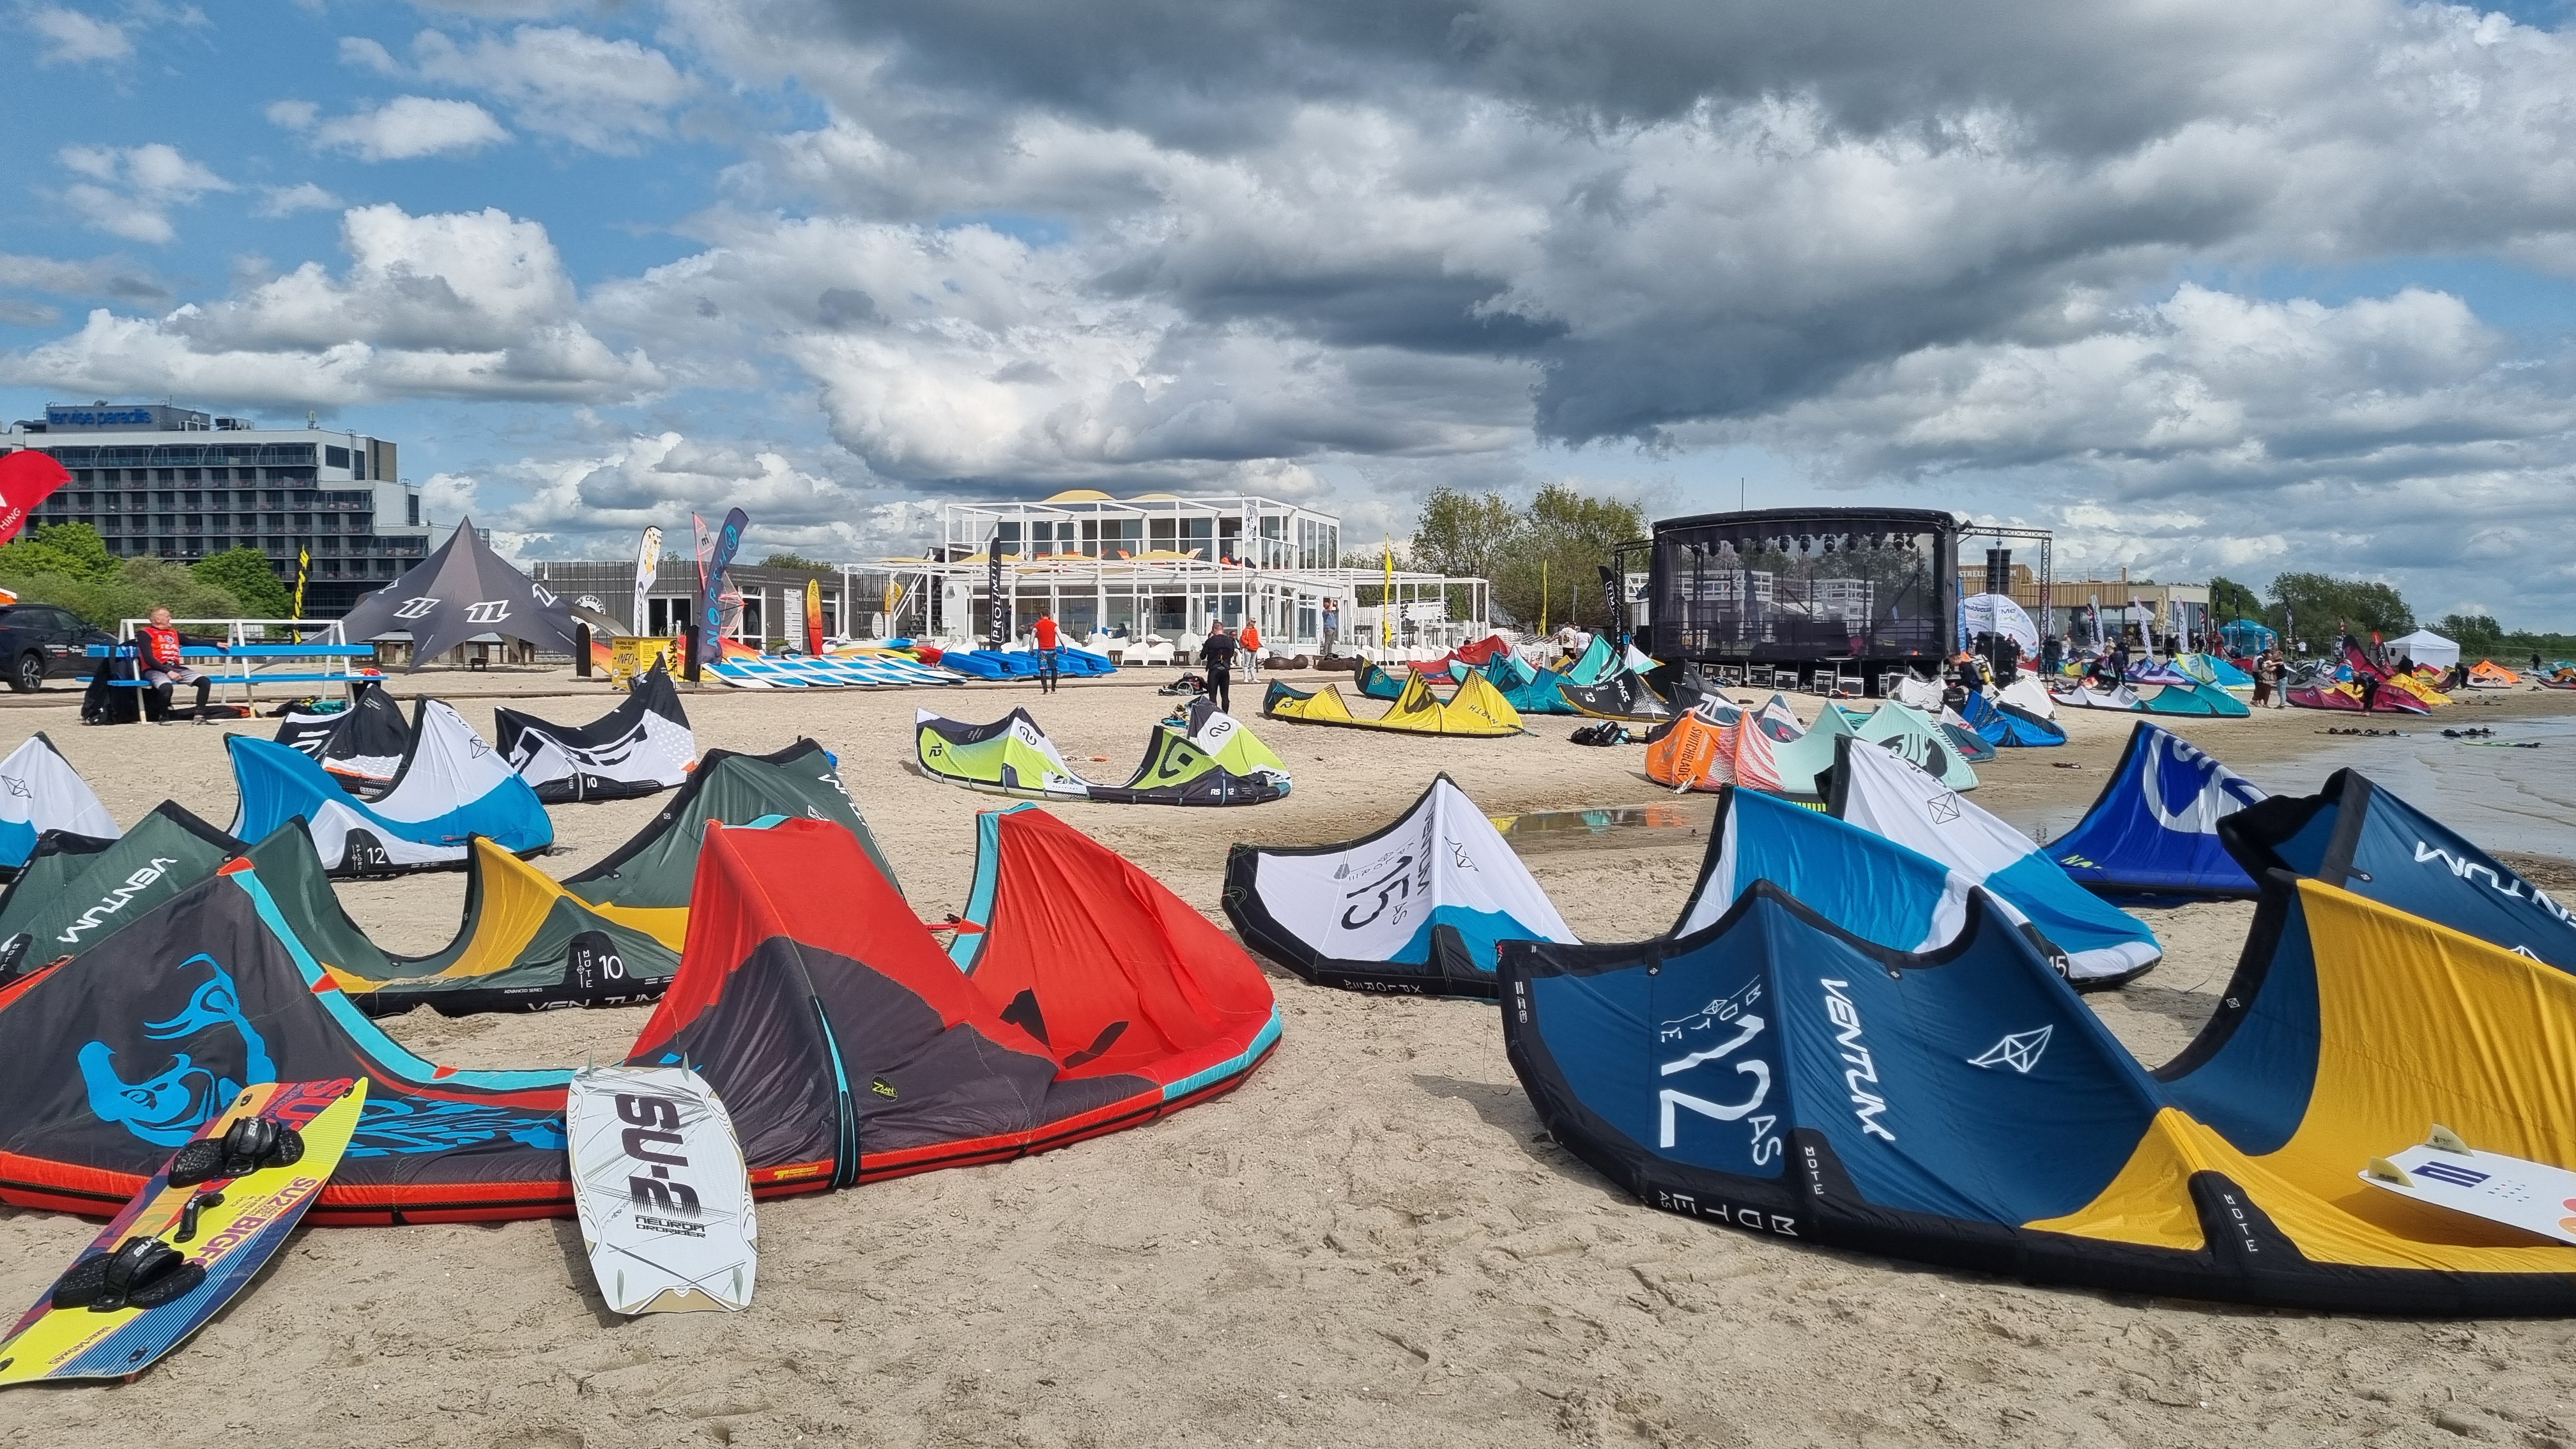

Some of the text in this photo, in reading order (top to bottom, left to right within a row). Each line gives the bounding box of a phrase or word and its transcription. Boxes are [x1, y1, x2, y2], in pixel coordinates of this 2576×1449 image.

[617, 653, 635, 665] INFO
[1616, 679, 1631, 703] PACE
[929, 742, 942, 758] 12
[1677, 726, 1702, 777] SWITCHBLADE
[587, 778, 597, 788] 10
[367, 847, 386, 864] 12
[1417, 802, 1436, 896] VENTUM
[56, 857, 178, 943] VENTUM
[1341, 855, 1413, 930] 15
[1393, 901, 1408, 926] AS
[583, 949, 594, 988] MOTE
[599, 955, 624, 979] 10
[1820, 978, 1896, 1140] VENTUM
[1660, 1014, 1771, 1148] 12
[1748, 1115, 1782, 1166] AS
[1804, 1146, 1825, 1195] MOTE
[269, 1177, 325, 1206] SU2
[1659, 1190, 1672, 1209] AS
[1673, 1193, 1799, 1236] MOTE
[2223, 1193, 2258, 1252] MOTE
